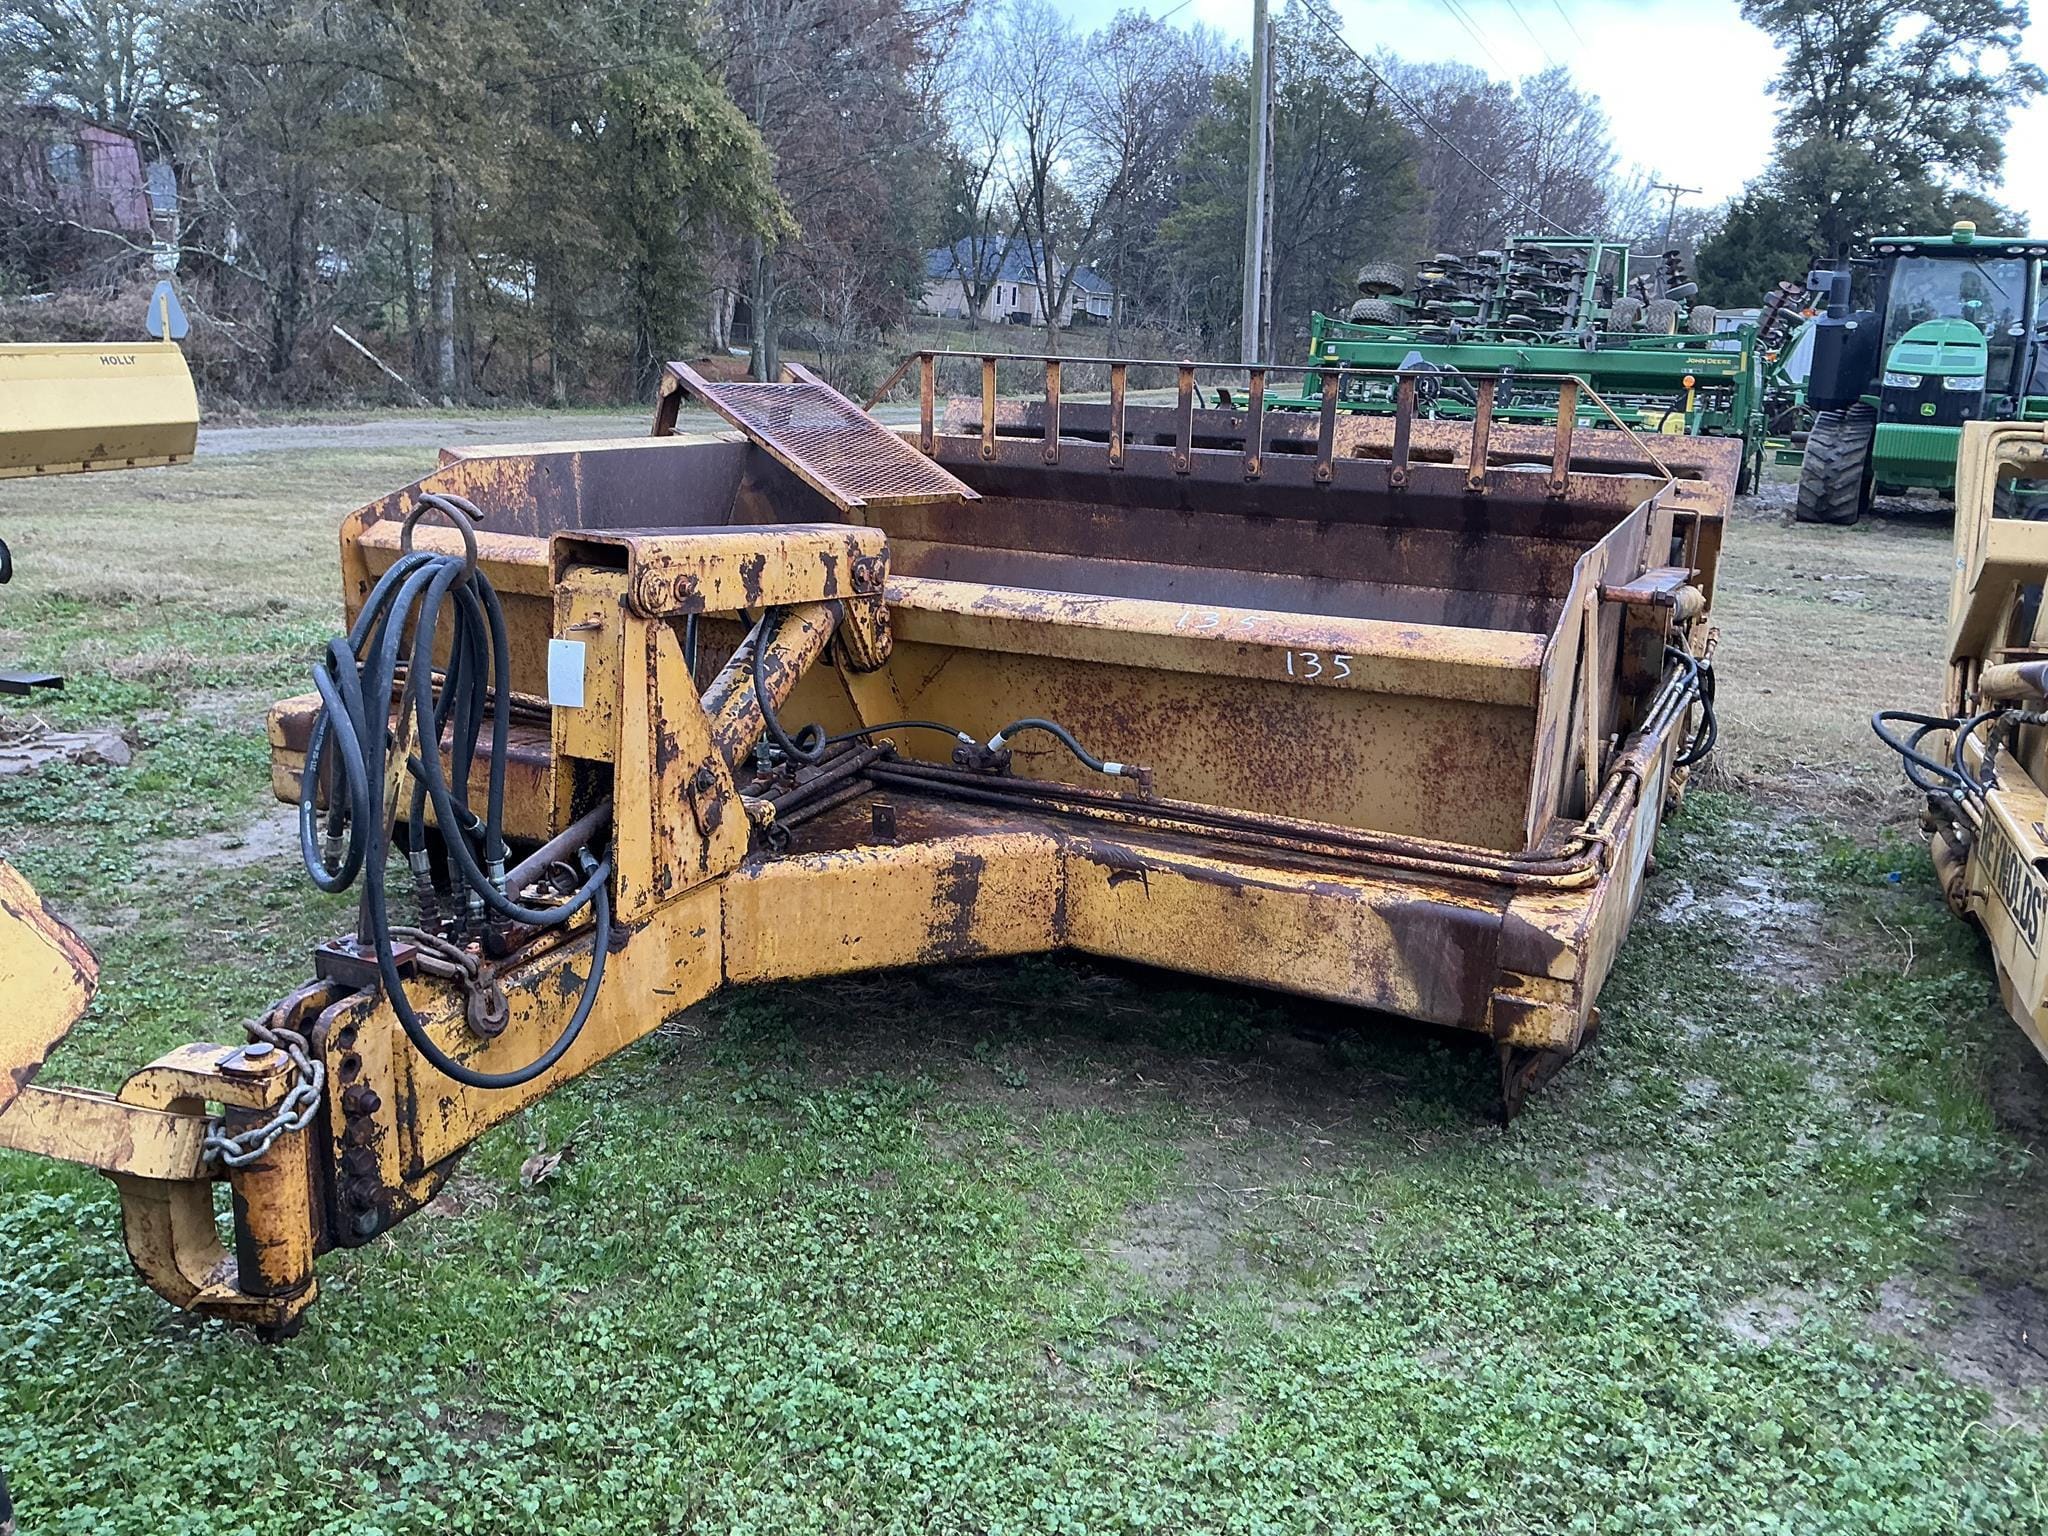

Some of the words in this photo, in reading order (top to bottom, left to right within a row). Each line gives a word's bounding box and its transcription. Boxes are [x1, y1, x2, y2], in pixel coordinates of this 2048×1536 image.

[100, 355, 136, 366] HOLLY
[1175, 611, 1269, 632] 135
[1286, 650, 1354, 680] 135
